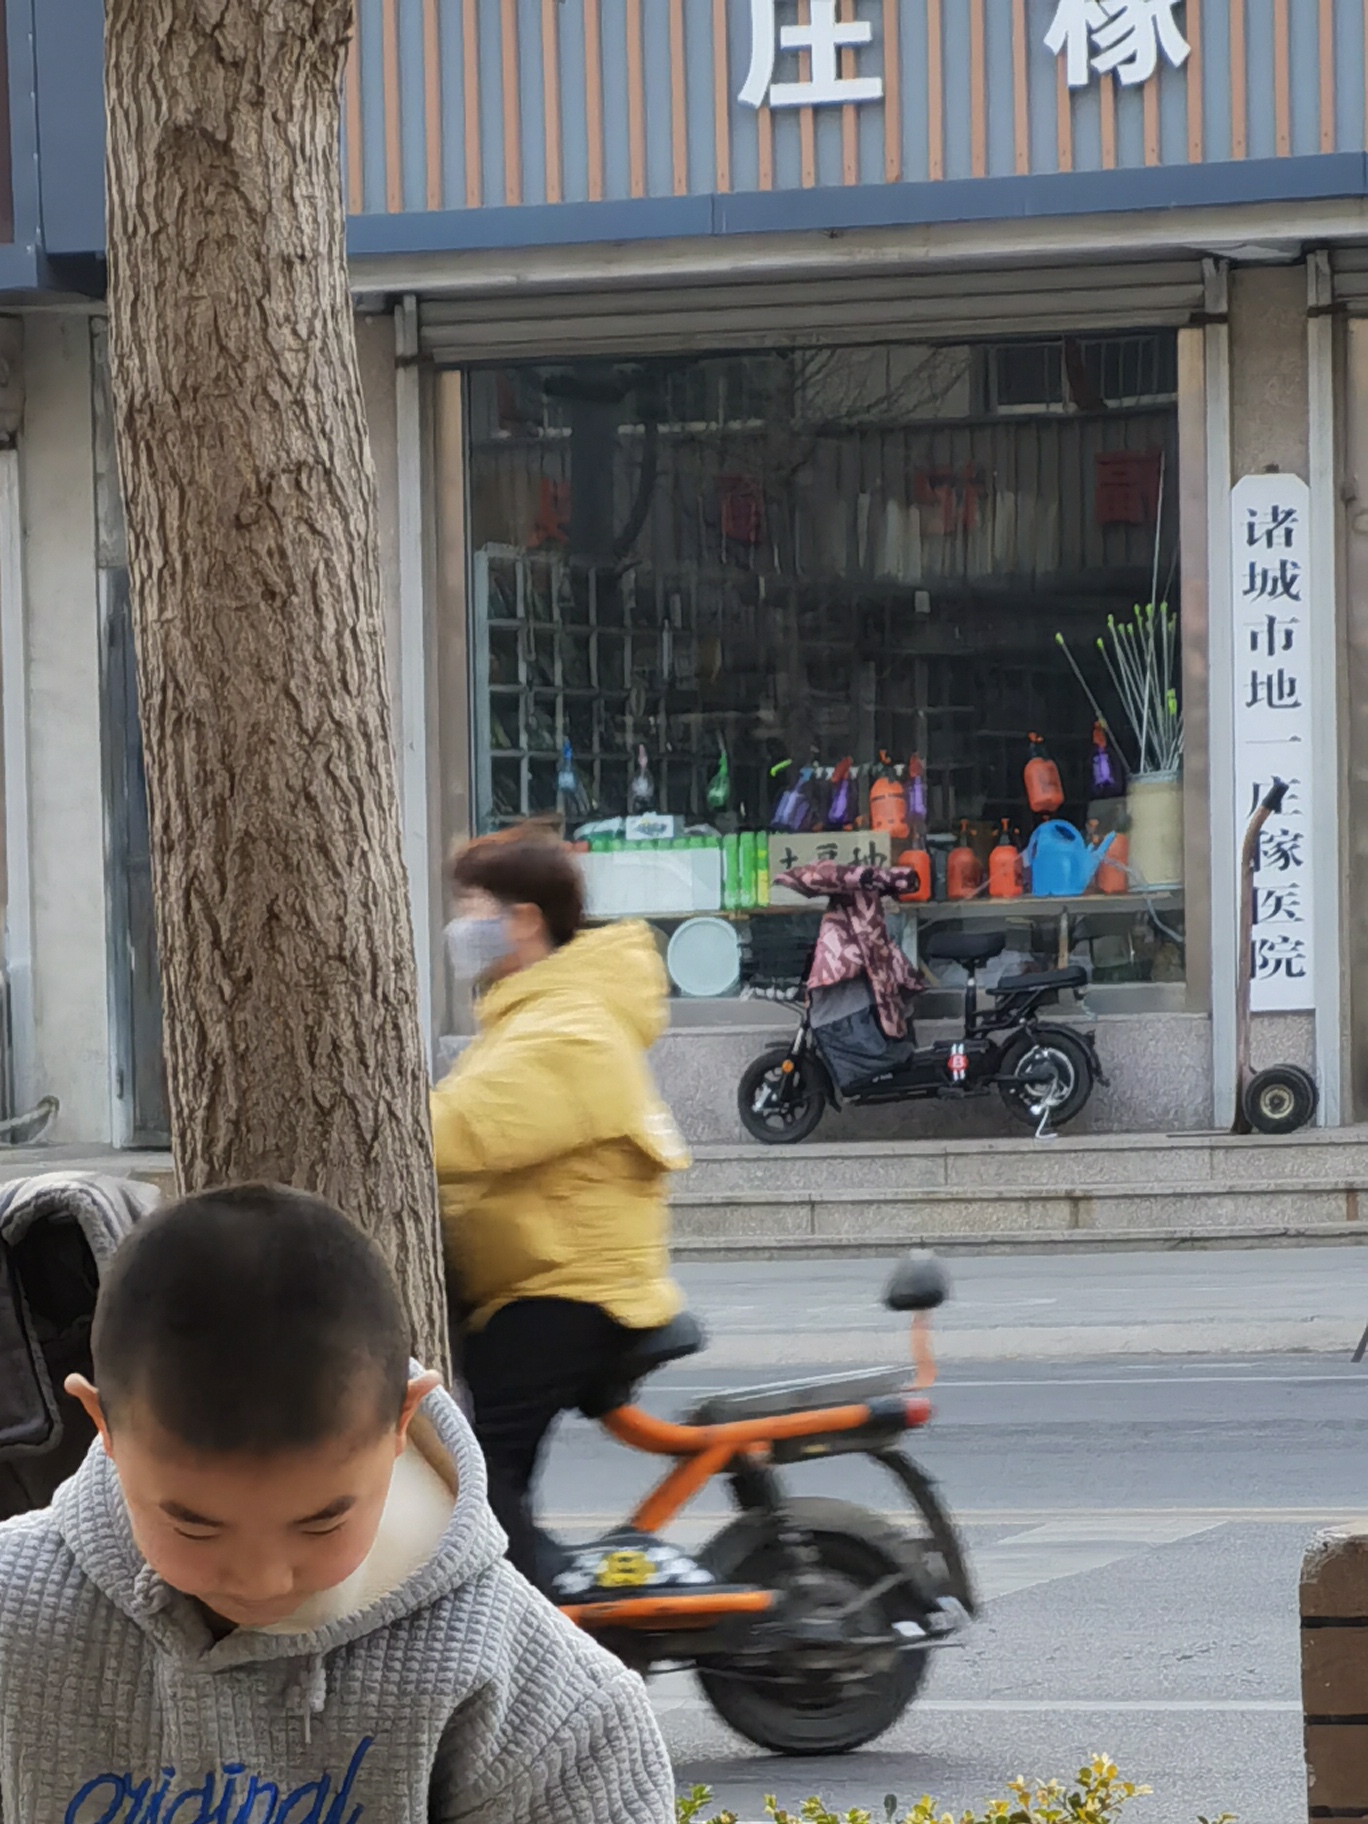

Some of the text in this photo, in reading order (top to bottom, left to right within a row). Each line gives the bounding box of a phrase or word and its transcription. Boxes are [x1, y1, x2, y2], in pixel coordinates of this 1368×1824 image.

[1240, 503, 1308, 981] 诸城市地一庄稼医院
